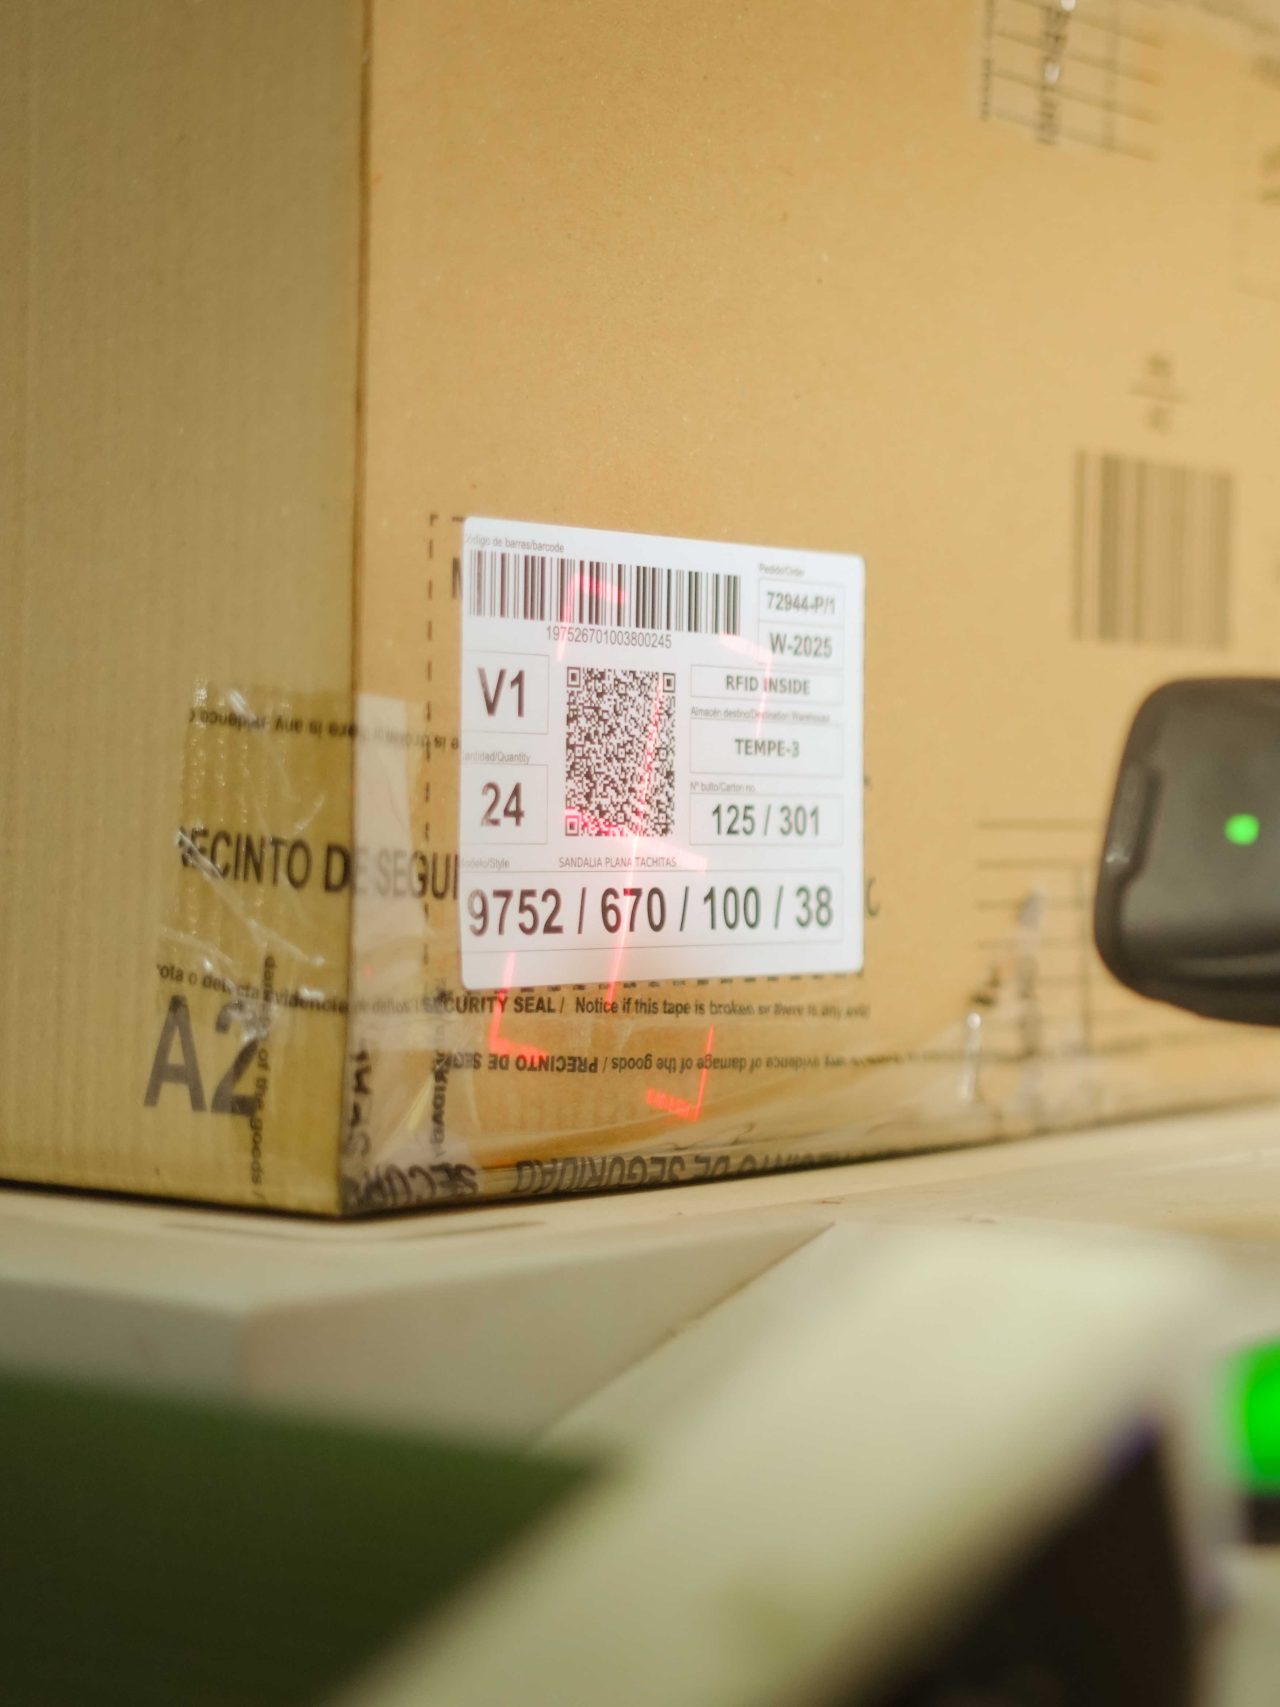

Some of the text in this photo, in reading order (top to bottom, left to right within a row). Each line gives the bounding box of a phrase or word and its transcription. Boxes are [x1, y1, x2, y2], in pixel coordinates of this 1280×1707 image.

[505, 537, 564, 552] barras/barcode
[767, 590, 836, 615] 72944-P/1
[546, 625, 672, 648] 197526701003800245
[769, 632, 832, 659] W-2025
[478, 667, 525, 718] V1
[725, 674, 810, 696] RFID INSIDE
[734, 737, 800, 759] TEMPE-3
[481, 782, 525, 828] 24
[712, 803, 820, 836] 125 / 301
[558, 857, 678, 869] SANDALIA PLANA TACHITAS
[467, 886, 563, 937] 9752
[576, 886, 587, 935] /
[600, 886, 666, 934] 670
[678, 885, 689, 933] /
[703, 885, 762, 931] 100
[774, 885, 784, 930] /
[794, 885, 834, 928] 38
[513, 996, 556, 1014] SEAL
[575, 997, 619, 1014] Notice
[622, 997, 633, 1014] if
[635, 997, 659, 1015] this
[662, 999, 690, 1018] tape
[695, 1000, 705, 1015] is
[709, 1000, 754, 1016] broken
[144, 994, 262, 1118] A2
[488, 1054, 509, 1071] DE
[515, 1054, 599, 1073] PRECINTO
[611, 1053, 652, 1073] goods
[655, 1055, 677, 1073] the
[679, 1055, 694, 1072] of
[696, 1055, 747, 1072] damage
